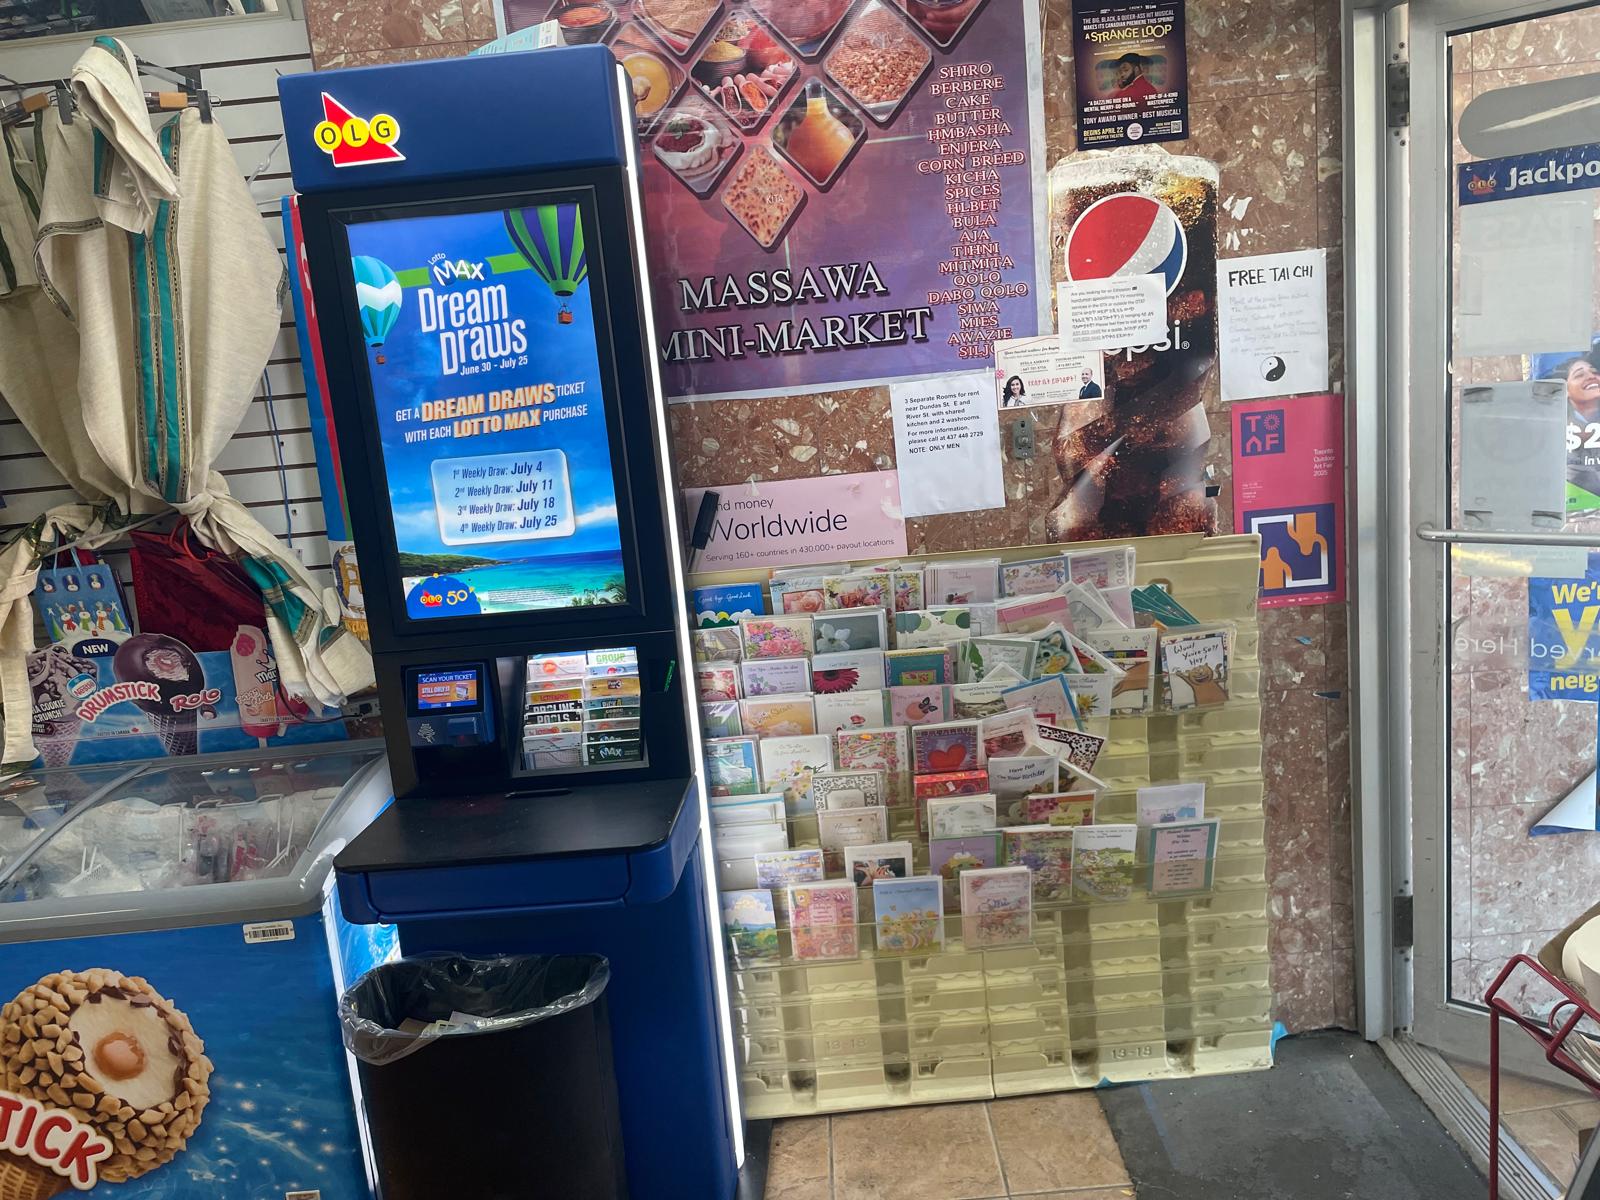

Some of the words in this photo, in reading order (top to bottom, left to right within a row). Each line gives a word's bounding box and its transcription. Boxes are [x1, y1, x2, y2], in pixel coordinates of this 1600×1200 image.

[1091, 28, 1140, 43] STRANGE
[1142, 24, 1172, 38] LOOP
[940, 64, 992, 79] SHIRO
[931, 78, 1004, 95] BERBERE
[946, 94, 990, 108] CAKE
[936, 108, 1002, 125] BUTTER
[318, 117, 396, 149] OLG
[928, 122, 1012, 140] HMBASHA
[940, 139, 1001, 156] ENJERA
[918, 158, 966, 173] CORN
[972, 152, 1025, 168] BREED
[946, 170, 999, 185] KICHA
[766, 194, 784, 204] KITA
[946, 184, 1000, 200] SPICES
[953, 214, 996, 228] BULA
[960, 230, 990, 242] AJA
[952, 243, 1000, 257] TIHNI
[428, 252, 446, 266] Lotto
[940, 256, 1014, 273] MITMITA
[432, 259, 486, 287] MAX
[954, 271, 1000, 287] QOLO
[1228, 268, 1266, 288] FREE
[1269, 267, 1290, 282] TAI
[1293, 265, 1313, 278] CHI
[680, 261, 887, 310] MASSAWA
[928, 288, 974, 304] DABO
[980, 284, 1028, 299] QOLO
[418, 284, 509, 333] Dream
[958, 302, 1000, 316] SIWA
[960, 316, 998, 329] MIES
[949, 328, 1012, 344] AWAZIE
[439, 318, 528, 376] Draws
[460, 363, 479, 376] June
[482, 362, 492, 373] 30
[500, 357, 516, 370] July
[518, 355, 528, 367] 25
[395, 408, 412, 422] GET
[414, 408, 420, 420] A
[421, 394, 484, 423] DREAM
[488, 383, 556, 412] DRAWS
[556, 382, 586, 397] TICKET
[910, 396, 935, 404] Separate
[945, 408, 966, 416] shared
[404, 430, 428, 444] WITH
[429, 426, 452, 440] EACH
[453, 416, 503, 438] LOTTO
[504, 408, 542, 431] MAX
[542, 404, 588, 422] PURCHASE
[906, 420, 928, 428] kitchen
[929, 444, 946, 452] ONLY
[462, 466, 486, 479] Weekly
[488, 466, 508, 477] Draw:
[510, 462, 533, 476] July
[535, 461, 543, 472] 4
[455, 486, 466, 498] 2nd
[467, 485, 492, 498] Weekly
[493, 484, 514, 495] Draw:
[516, 480, 538, 494] July
[542, 478, 554, 490] 11
[457, 505, 468, 516] 3rd
[469, 503, 494, 516] Weekly
[496, 502, 516, 513] Draw:
[517, 498, 540, 512] July
[543, 496, 555, 508] 18
[734, 498, 774, 511] money
[460, 522, 469, 534] 4th
[471, 521, 496, 534] Weekly
[498, 520, 517, 531] Draw:
[520, 516, 542, 530] July
[545, 514, 558, 527] 25
[708, 509, 848, 542] Worldwide
[706, 552, 734, 562] Serving
[736, 551, 754, 560] 160+
[756, 548, 789, 558] countries
[836, 541, 861, 551] payout
[862, 538, 895, 548] locations
[446, 590, 468, 606] 50
[82, 644, 109, 654] NEW
[596, 653, 626, 664] GROUP
[40, 700, 66, 712] COOKIE
[78, 682, 160, 722] DRUMSTICK
[33, 710, 63, 723] CRUNCH
[0, 1096, 106, 1183] TICK
